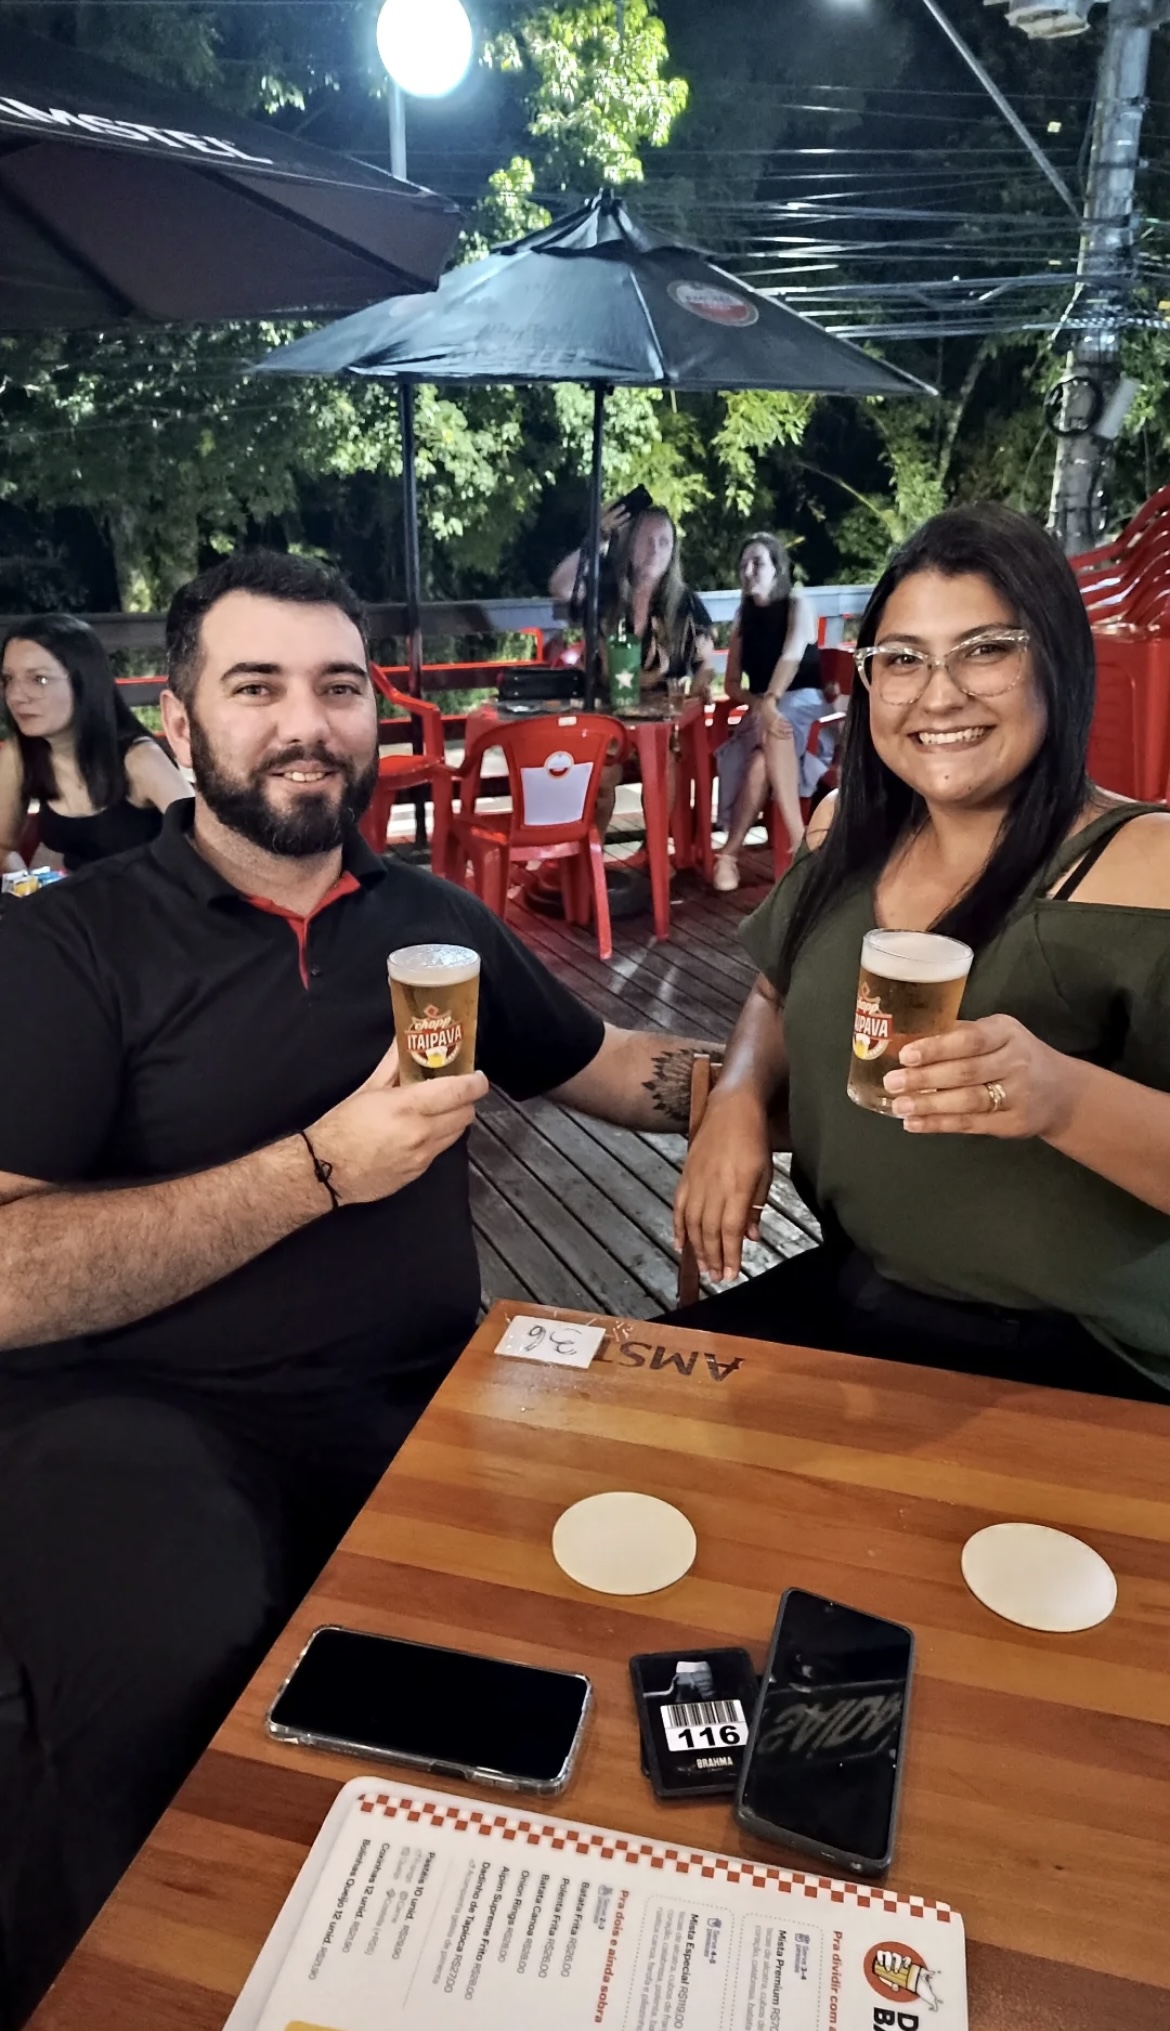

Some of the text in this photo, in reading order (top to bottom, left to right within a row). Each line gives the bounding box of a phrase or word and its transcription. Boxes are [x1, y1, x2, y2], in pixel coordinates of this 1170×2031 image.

[408, 1025, 462, 1050] ITAIPAVA
[678, 1725, 740, 1748] 116
[696, 1756, 733, 1769] BRAHMA
[350, 1839, 370, 1876] Bolinhas
[368, 1843, 390, 1883] Coxinhas
[418, 1852, 435, 1884] Pastéis
[364, 1885, 374, 1895] 12
[414, 1887, 424, 1896] 10
[496, 1866, 509, 1892] Aipim
[516, 1870, 529, 1897] Onion
[536, 1874, 549, 1903] Batata
[336, 1878, 355, 1908] Queijo
[618, 1890, 629, 1909] Pra
[333, 1910, 343, 1919] 12
[355, 1897, 370, 1919] unid.
[405, 1898, 420, 1921] unid.
[483, 1894, 502, 1936] Supreme
[506, 1899, 521, 1925] Rings
[527, 1906, 541, 1936] Canoa
[323, 1922, 338, 1945] unid.
[444, 1862, 490, 1993] Dadinho de Tapioca R$27,00
[539, 1878, 570, 1978] Polenta Frita R$26,00
[561, 1882, 589, 1977] Batata Frita R$26,00
[598, 1918, 606, 1930] 2-3
[613, 1912, 625, 1936] dois
[688, 1914, 698, 1940] Mista
[476, 1939, 489, 1961] Frito
[777, 1931, 787, 1957] Mista
[833, 1931, 842, 1951] Pra
[604, 1949, 618, 1983] ainda
[680, 1942, 694, 1984] Especial
[830, 1954, 842, 1993] dividir
[772, 1959, 784, 2005] Premium
[595, 1986, 610, 2023] sobra
[829, 1996, 838, 2023] com
[873, 2006, 895, 2031] B
